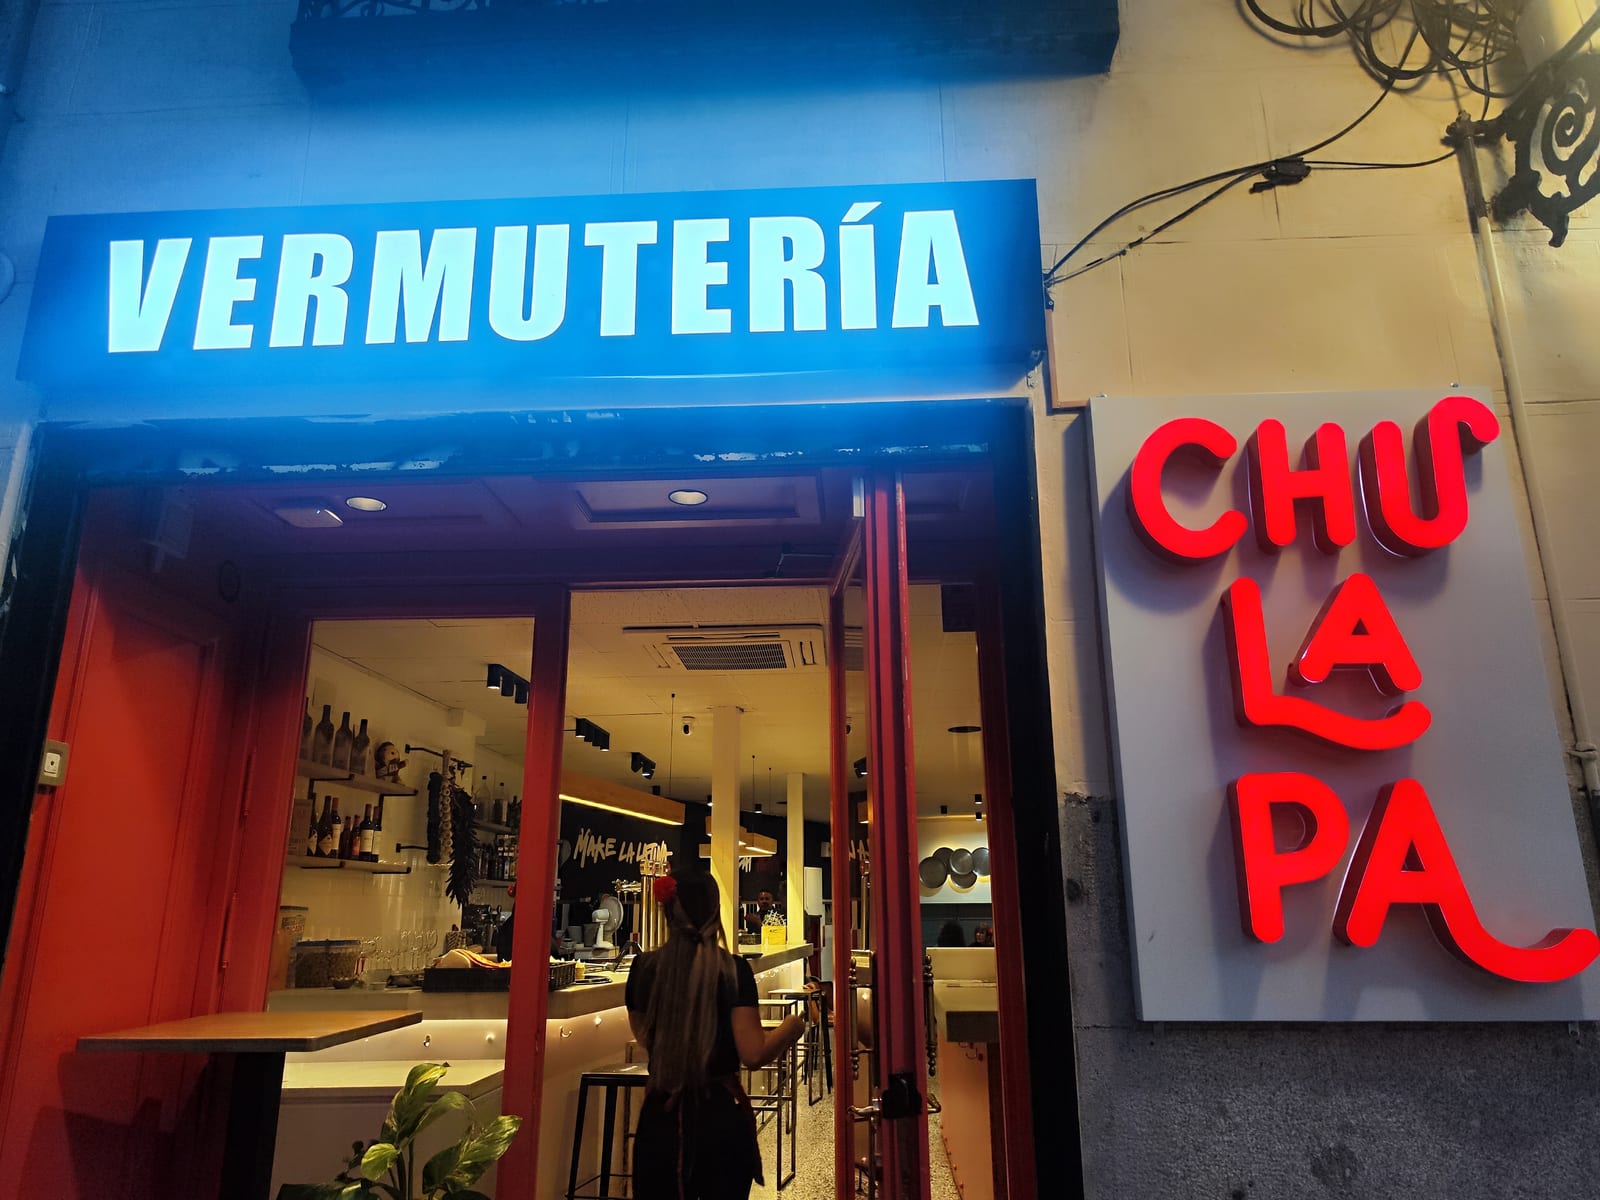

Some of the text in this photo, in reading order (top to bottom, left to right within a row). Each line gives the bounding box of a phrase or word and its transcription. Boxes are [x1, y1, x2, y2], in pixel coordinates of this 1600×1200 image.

[107, 201, 980, 353] VERMUTERÍA
[1129, 396, 1500, 560] CHU
[1224, 573, 1432, 751] LA
[573, 827, 616, 868] MAKE
[618, 841, 635, 864] LA
[1232, 771, 1600, 982] PA
